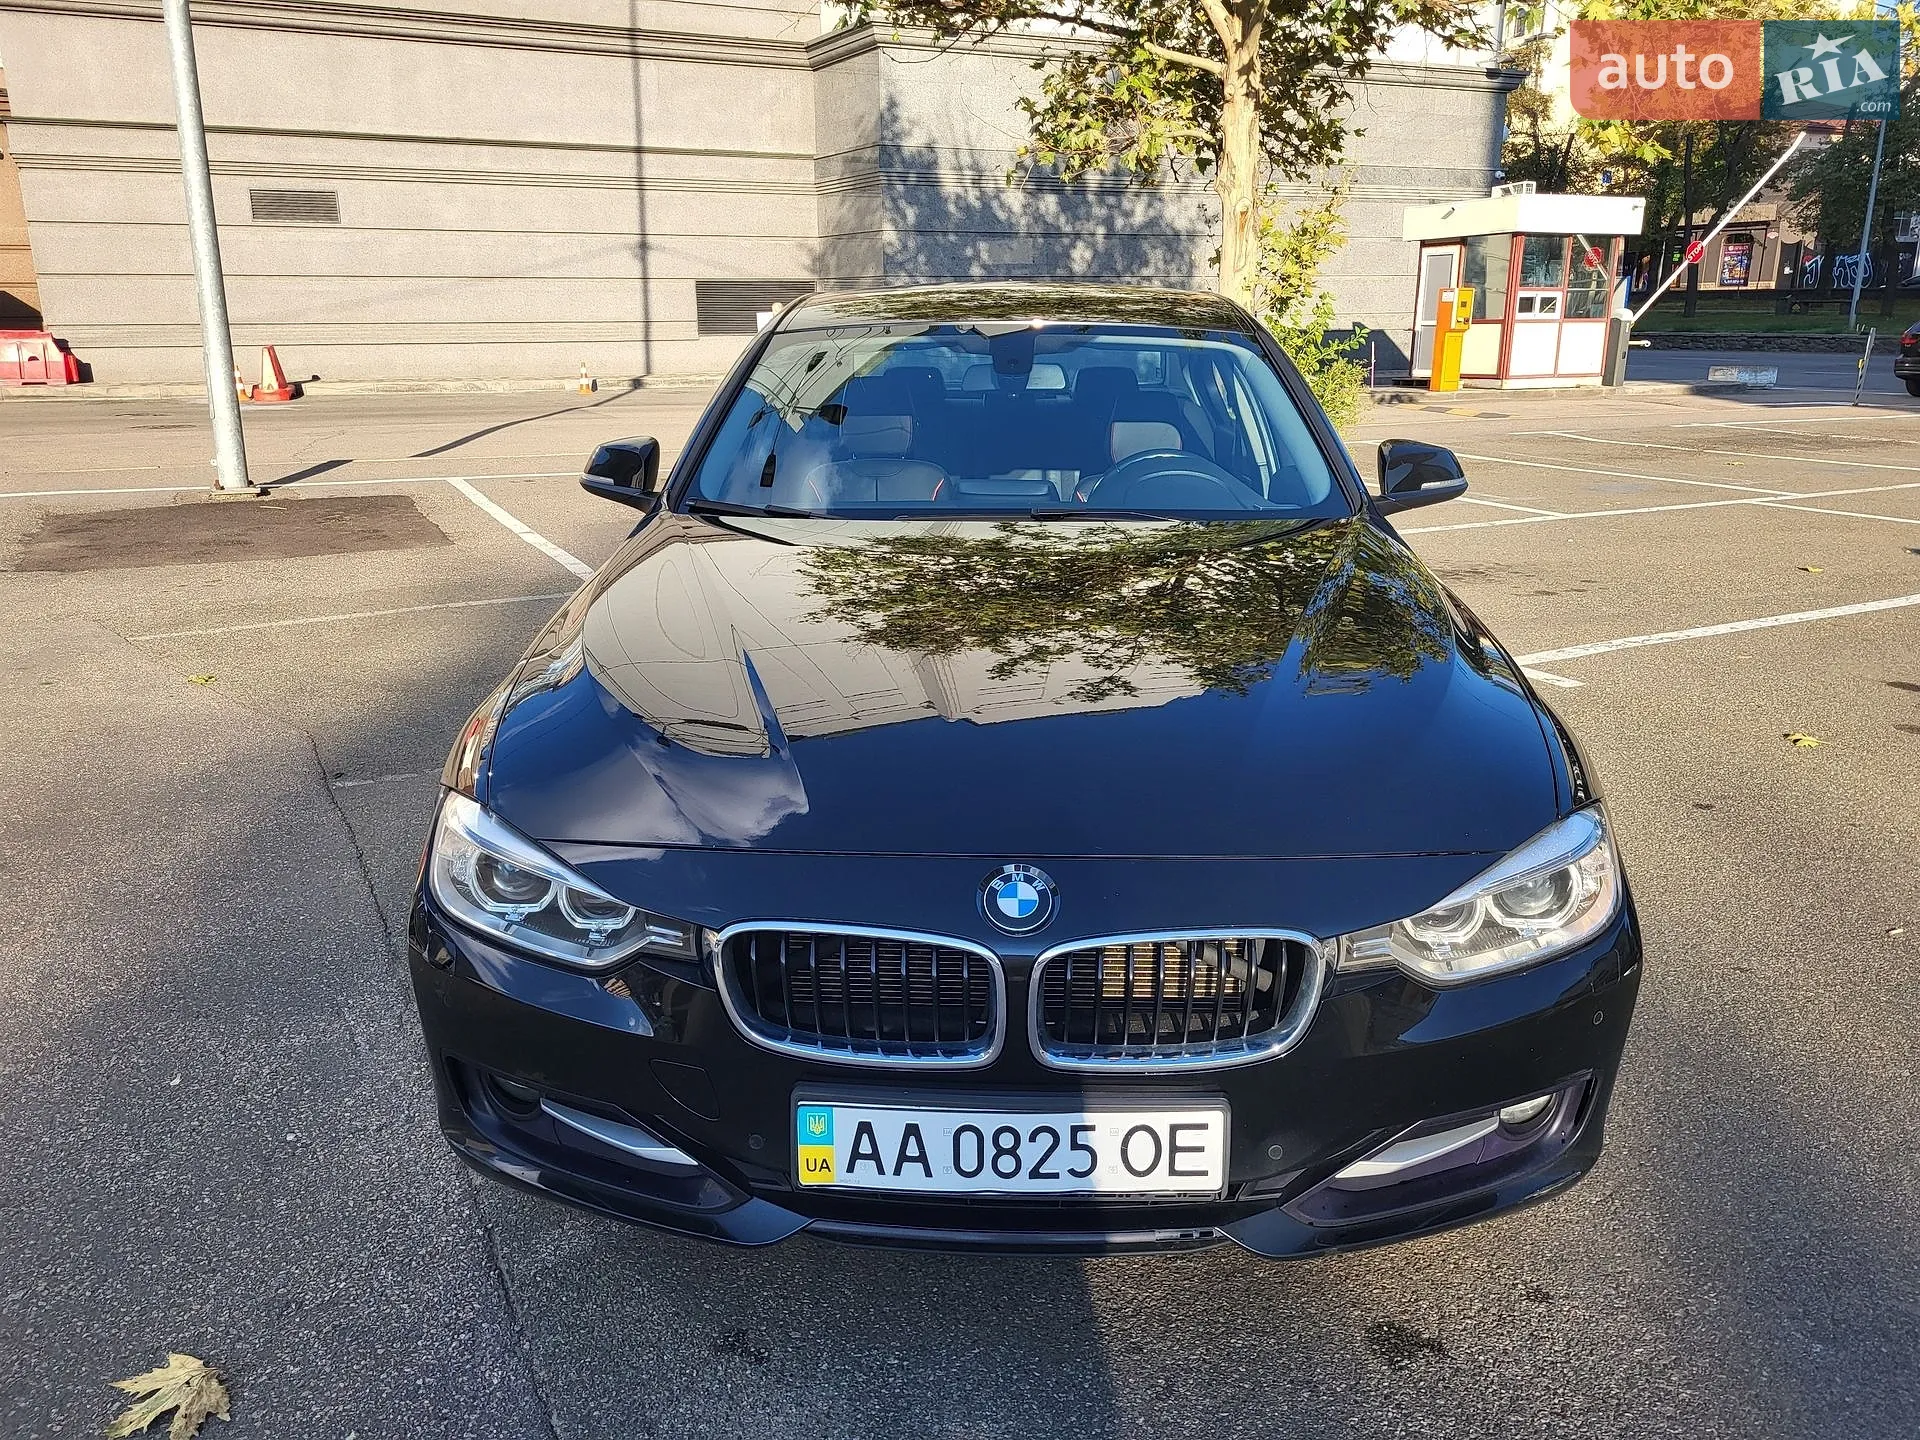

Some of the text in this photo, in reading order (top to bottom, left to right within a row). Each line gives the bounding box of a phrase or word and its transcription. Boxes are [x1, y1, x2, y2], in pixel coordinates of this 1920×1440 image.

[1687, 243, 1702, 261] STOP
[991, 873, 1045, 891] BMW
[846, 1121, 1209, 1180] AA 0825 OE
[806, 1158, 831, 1172] UA
